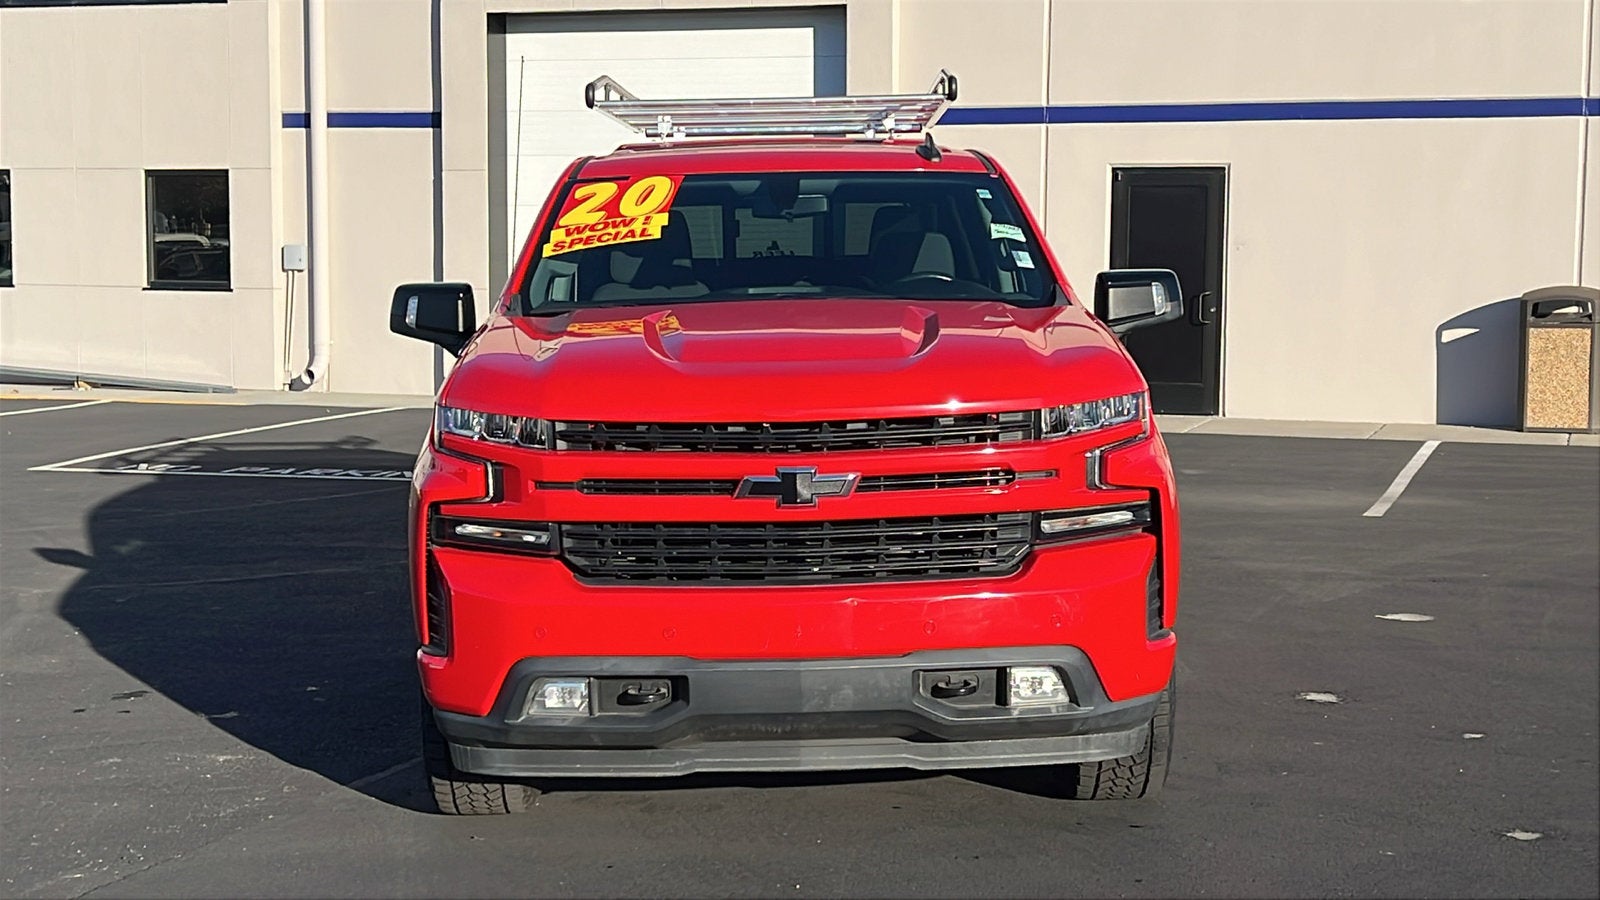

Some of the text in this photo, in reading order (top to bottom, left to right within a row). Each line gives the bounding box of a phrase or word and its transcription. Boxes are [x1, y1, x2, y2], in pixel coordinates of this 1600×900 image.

[558, 175, 674, 226] 20
[551, 227, 653, 252] SPECIAL
[565, 217, 638, 238] WOW
